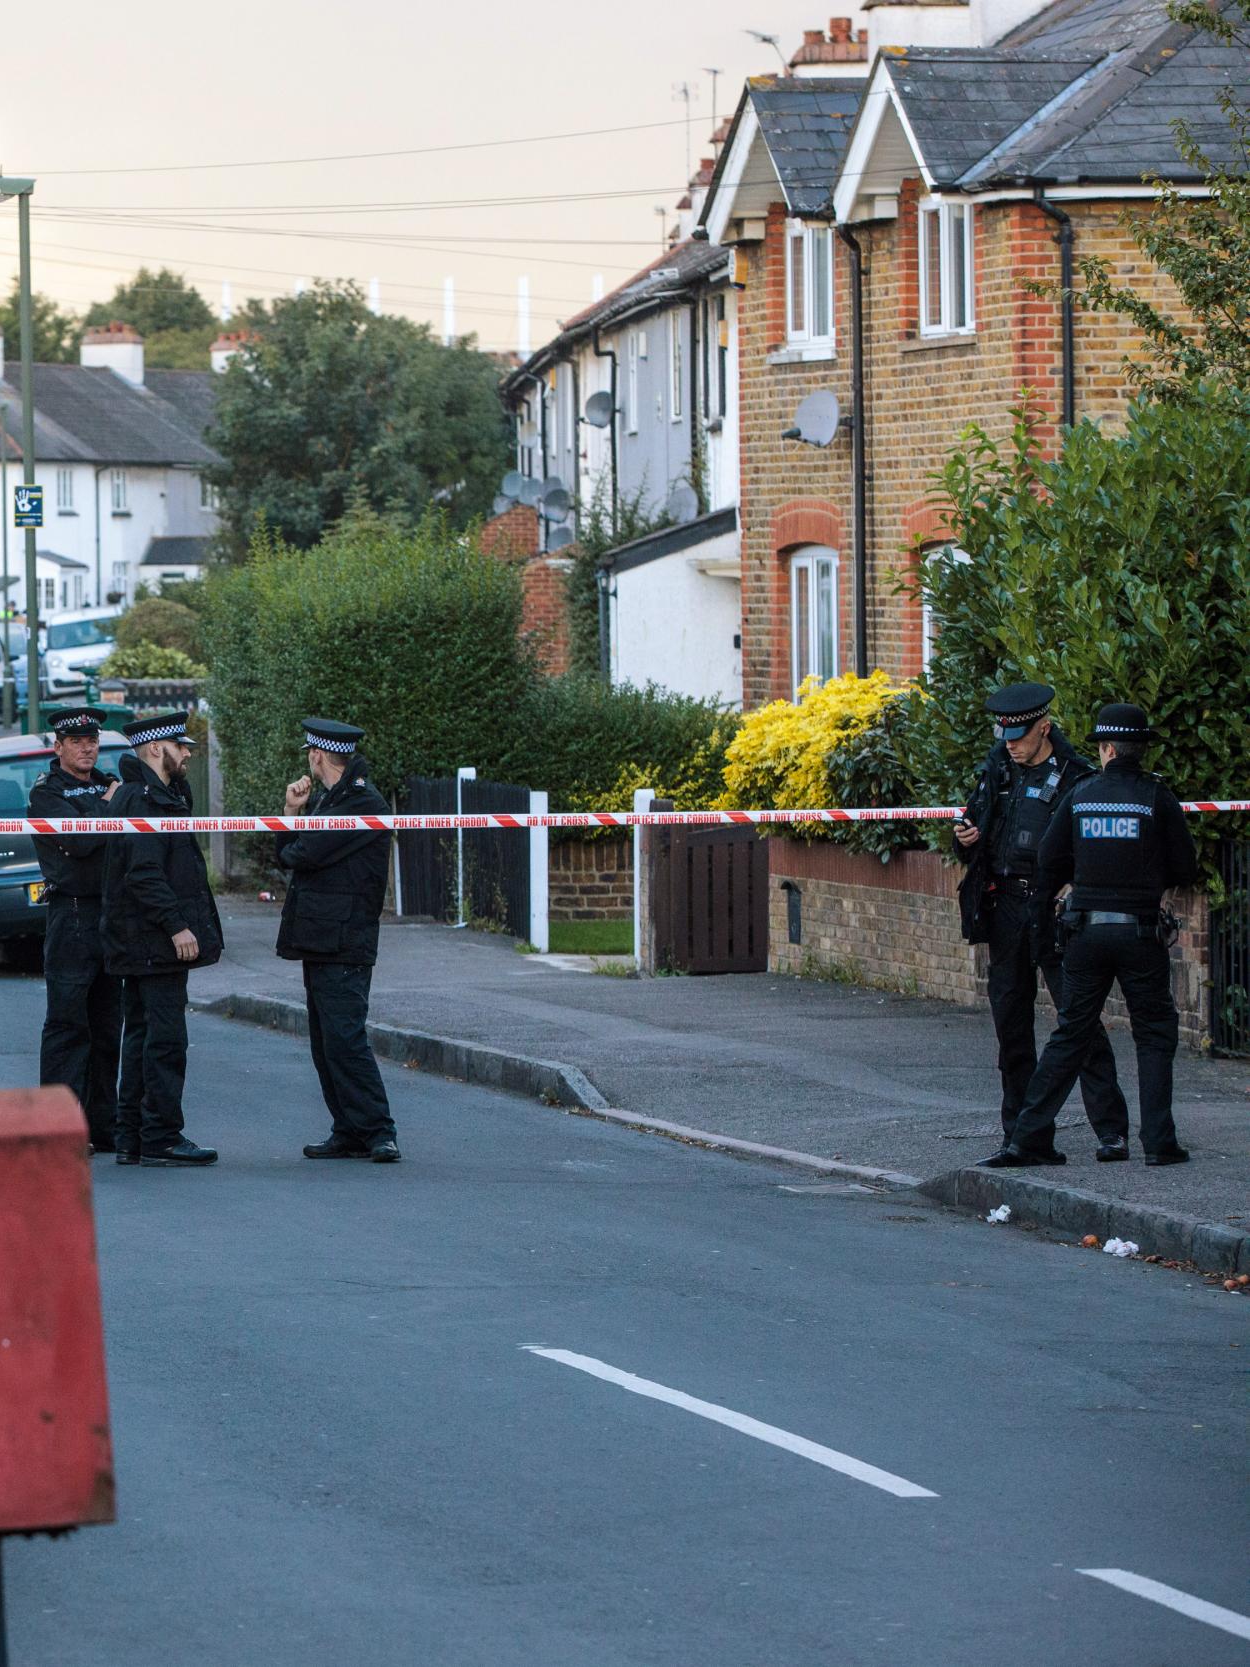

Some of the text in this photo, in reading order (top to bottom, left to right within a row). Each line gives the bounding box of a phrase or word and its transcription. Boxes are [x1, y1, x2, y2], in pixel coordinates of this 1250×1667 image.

[626, 814, 722, 824] POLICE INNER CORDON
[760, 813, 822, 822] DO NOT CROSS
[859, 810, 955, 820] POLICE INNER CORDON
[61, 820, 123, 831] DO NOT CROSS
[161, 819, 257, 831] POLICE INNER CORDON
[294, 818, 356, 829] DO NOT CROSS
[393, 817, 489, 828] POLICE INNER CORDON
[527, 816, 589, 826] DO NOT CROSS
[1082, 818, 1138, 838] POLICE
